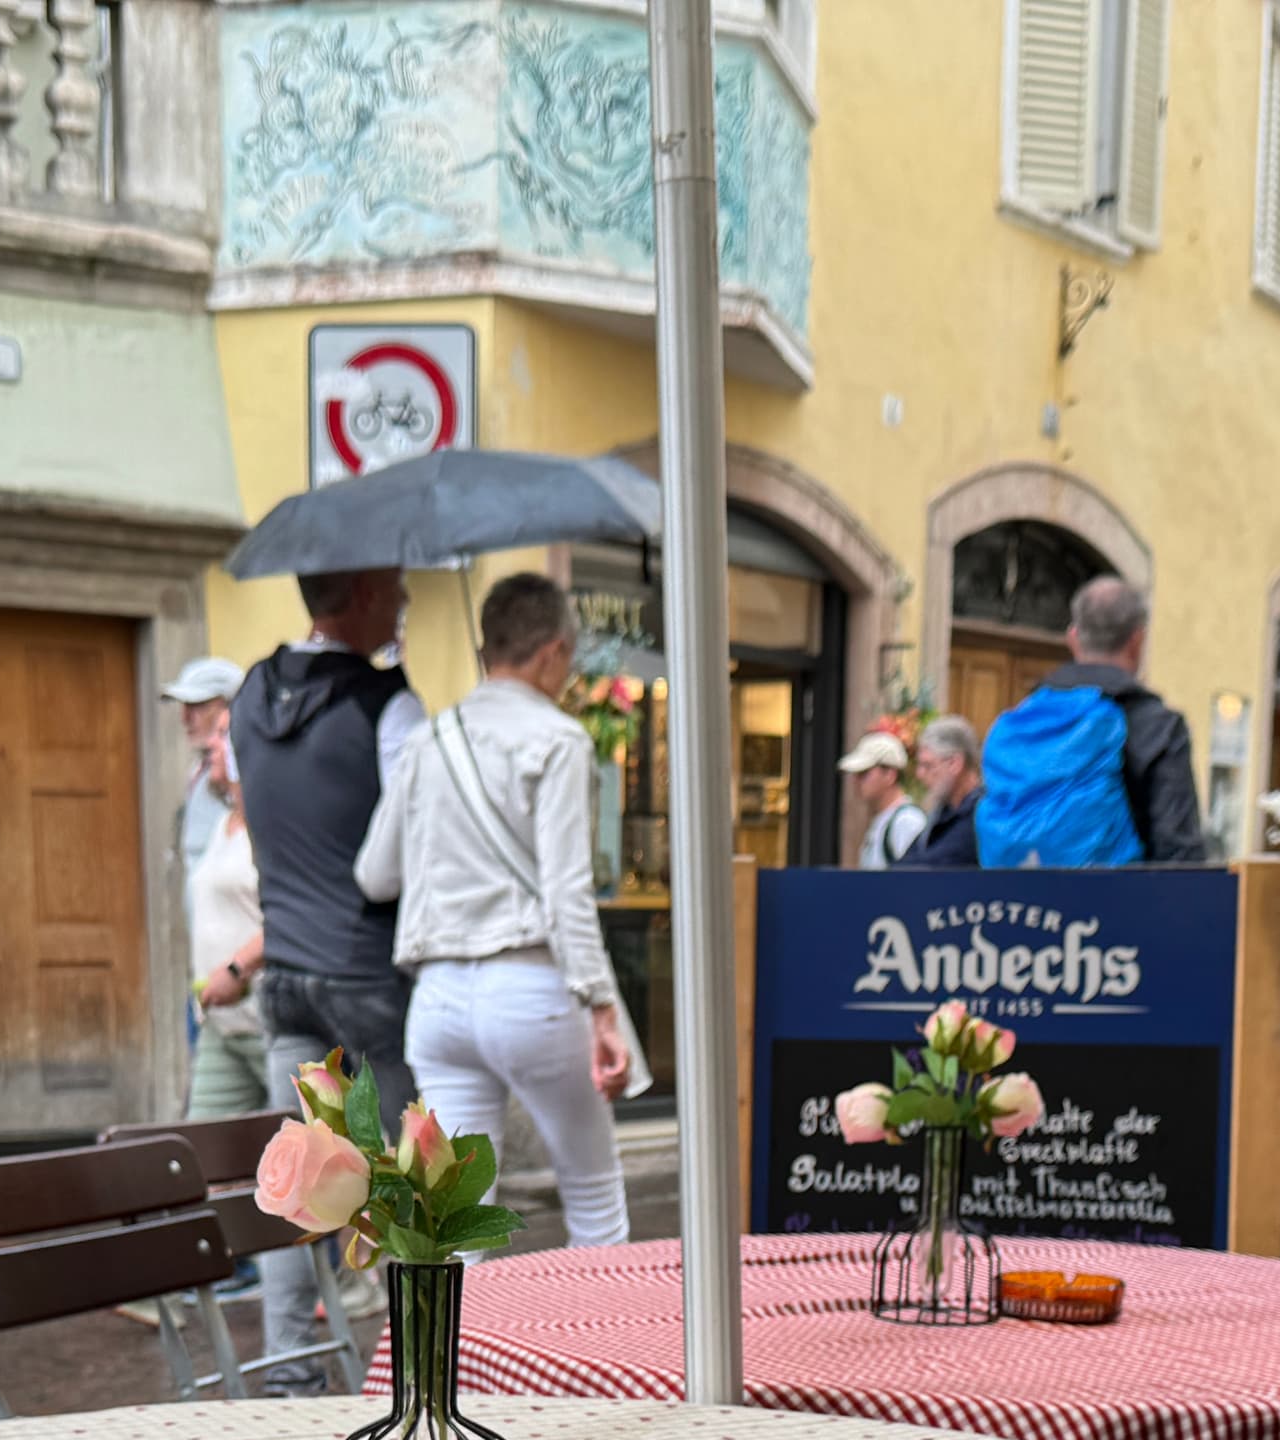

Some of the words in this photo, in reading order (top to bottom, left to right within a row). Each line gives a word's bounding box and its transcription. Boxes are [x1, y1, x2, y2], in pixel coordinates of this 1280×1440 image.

[926, 901, 1062, 933] KLOSTER
[853, 916, 1141, 1003] Andechs
[996, 997, 1043, 1017] 1455
[972, 1166, 1020, 1196] mit
[1031, 1166, 1168, 1201] Thunfisch
